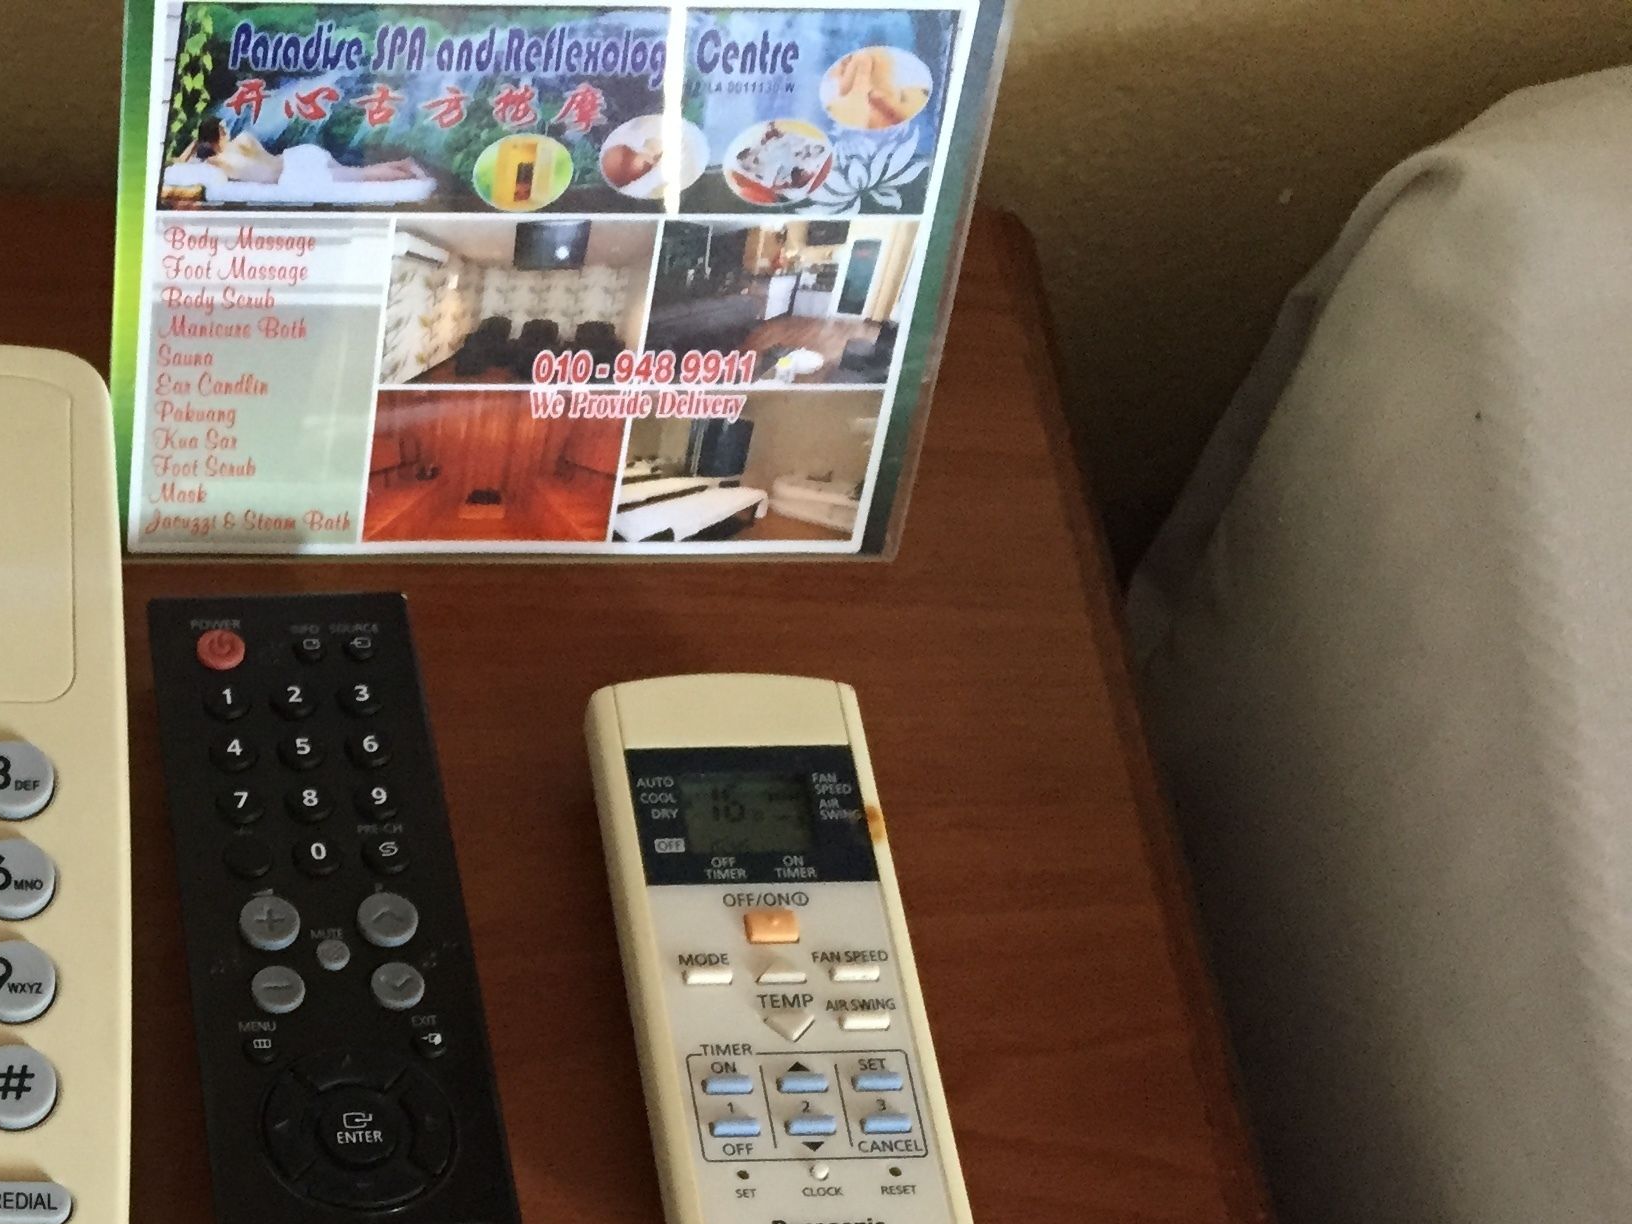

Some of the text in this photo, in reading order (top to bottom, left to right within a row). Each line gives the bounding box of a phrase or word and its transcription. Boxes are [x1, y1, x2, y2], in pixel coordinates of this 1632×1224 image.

[231, 22, 799, 87] Paradise SPA and Reflexolog Centre
[164, 226, 316, 256] Body Massage
[163, 256, 308, 286] Foot Massage
[161, 286, 275, 315] Body Scrub
[158, 315, 251, 338] Manicure
[158, 343, 213, 366] Sauna
[534, 352, 592, 383] 010
[614, 352, 676, 383] 948
[681, 352, 756, 383] 9911
[155, 371, 190, 396] Ear
[532, 392, 746, 422] We Provide Delivery
[152, 455, 256, 477] Foot Scrub
[150, 483, 206, 504] Mask
[244, 509, 296, 530] Steam
[222, 688, 232, 704] 1
[287, 686, 302, 702] 2
[354, 685, 369, 701] 3
[227, 739, 243, 755] 4
[295, 738, 311, 755] 5
[363, 735, 379, 752] 6
[636, 777, 674, 788] AUTO
[811, 772, 837, 784] FAN
[14, 779, 40, 791] DEF
[814, 783, 852, 795] SPEED
[234, 791, 248, 808] 7
[302, 789, 318, 806] 8
[371, 787, 387, 805] 9
[640, 793, 677, 804] COOL
[819, 799, 839, 809] AIR
[651, 808, 678, 820] DRY
[820, 809, 860, 821] SWING
[311, 842, 326, 860] 0
[657, 840, 682, 850] OFF
[711, 857, 736, 867] OFF
[782, 856, 804, 867] ON
[705, 868, 747, 880] TIMER
[775, 867, 817, 879] TIMER
[13, 878, 44, 891] MNO
[723, 892, 790, 907] OFF/ON
[678, 953, 730, 966] MODE
[811, 950, 889, 963] FAN SPEED
[7, 982, 43, 995] WXYZ
[757, 993, 814, 1009] TEMP
[825, 998, 896, 1011] AIR SWING
[239, 1021, 276, 1032] MENU
[411, 1015, 437, 1026] EXIT
[700, 1043, 752, 1057] TIMER
[710, 1062, 737, 1074] ON
[858, 1058, 886, 1071] SET
[727, 1102, 734, 1113] 1
[802, 1101, 810, 1112] 2
[877, 1100, 886, 1111] 3
[336, 1131, 383, 1144] ENTER
[722, 1143, 754, 1157] OFF
[858, 1139, 923, 1153] CANCEL
[735, 1188, 756, 1199] SET
[801, 1186, 844, 1197] CLOCK
[880, 1185, 916, 1195] RESET
